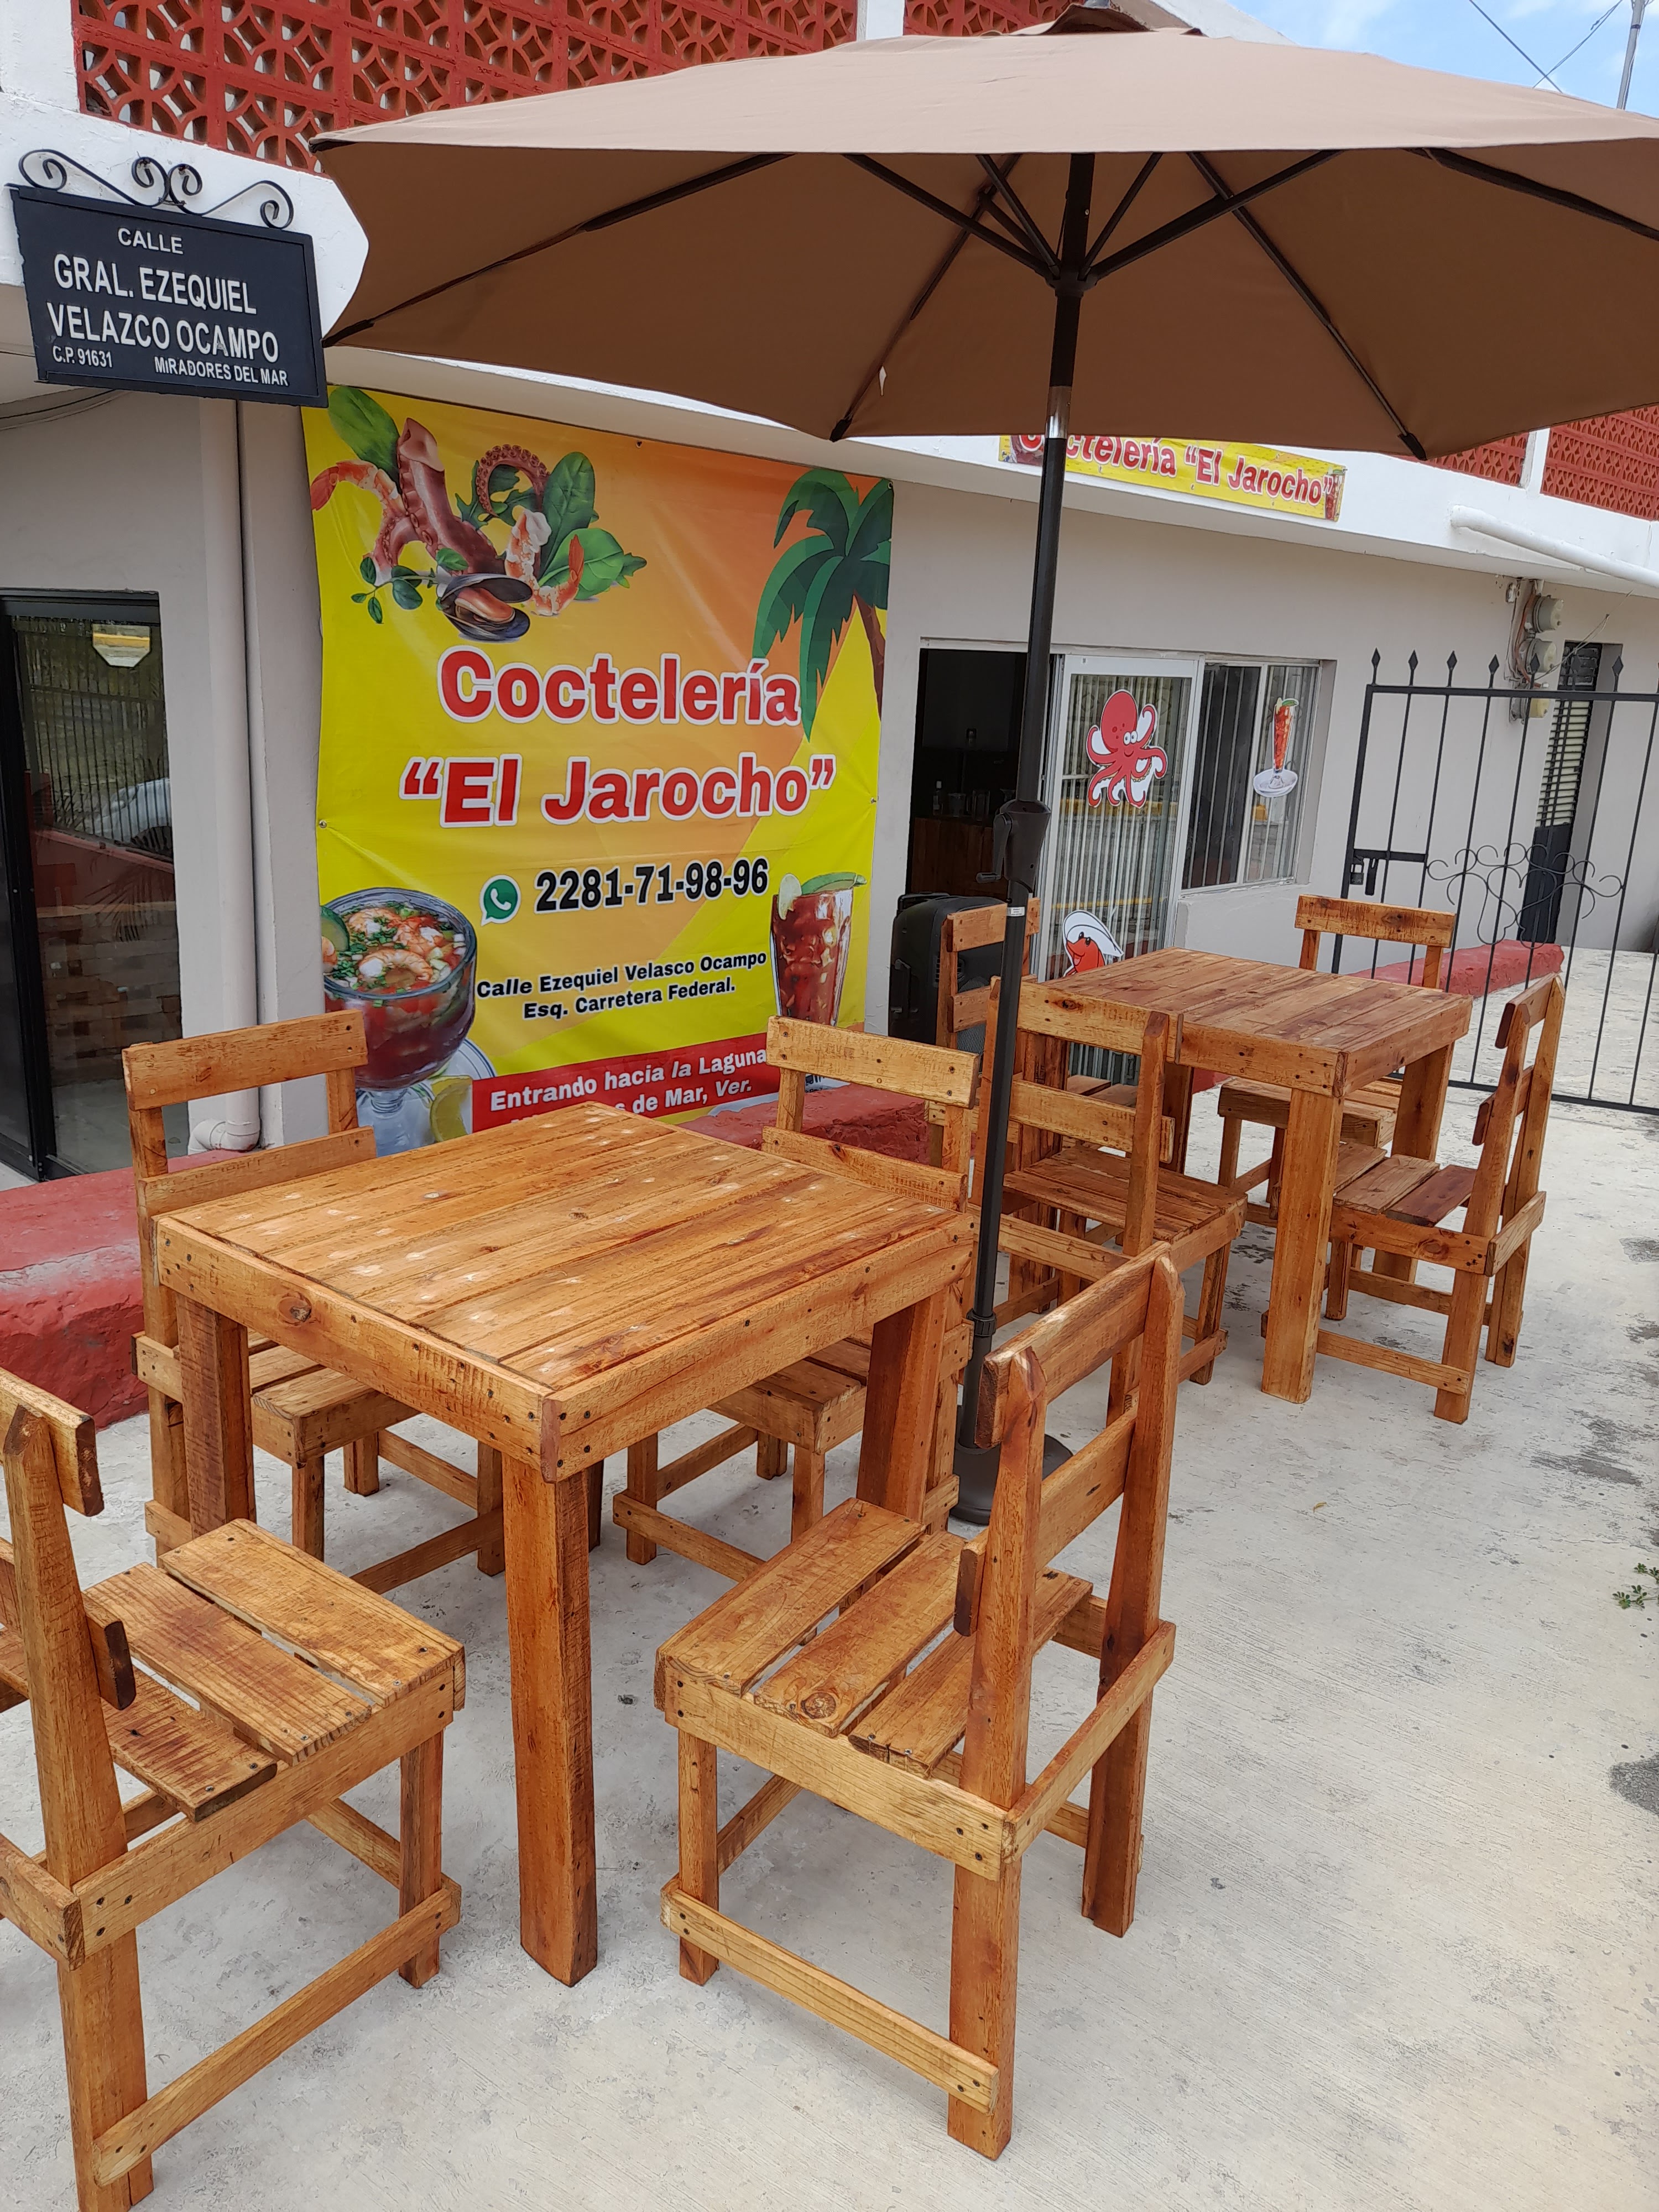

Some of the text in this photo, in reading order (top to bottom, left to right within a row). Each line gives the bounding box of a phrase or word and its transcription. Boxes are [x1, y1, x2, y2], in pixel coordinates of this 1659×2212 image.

[118, 228, 184, 254] CALLE
[54, 254, 257, 314] GRAL. EZEQUIEL
[47, 302, 278, 363] VELAZCO OCAMPO
[52, 346, 113, 368] C.P. 91631
[154, 356, 288, 386] MIRADORES DEL MAR
[1019, 435, 1176, 477] ctelería
[1227, 455, 1334, 505] Jarocho”
[439, 647, 800, 724] Coctelería
[401, 754, 836, 825] “El Jarocho”
[535, 858, 769, 914] 2281-71-98-96
[477, 952, 767, 998] Calle Ezequiel Velasco Ocampo
[524, 977, 735, 1020] Esq. Carretera Federal.
[491, 1048, 767, 1112] Entrando hacia la Laguna
[633, 1095, 659, 1114] de
[665, 1086, 708, 1105] Mar,
[716, 1077, 752, 1097] Ver.
